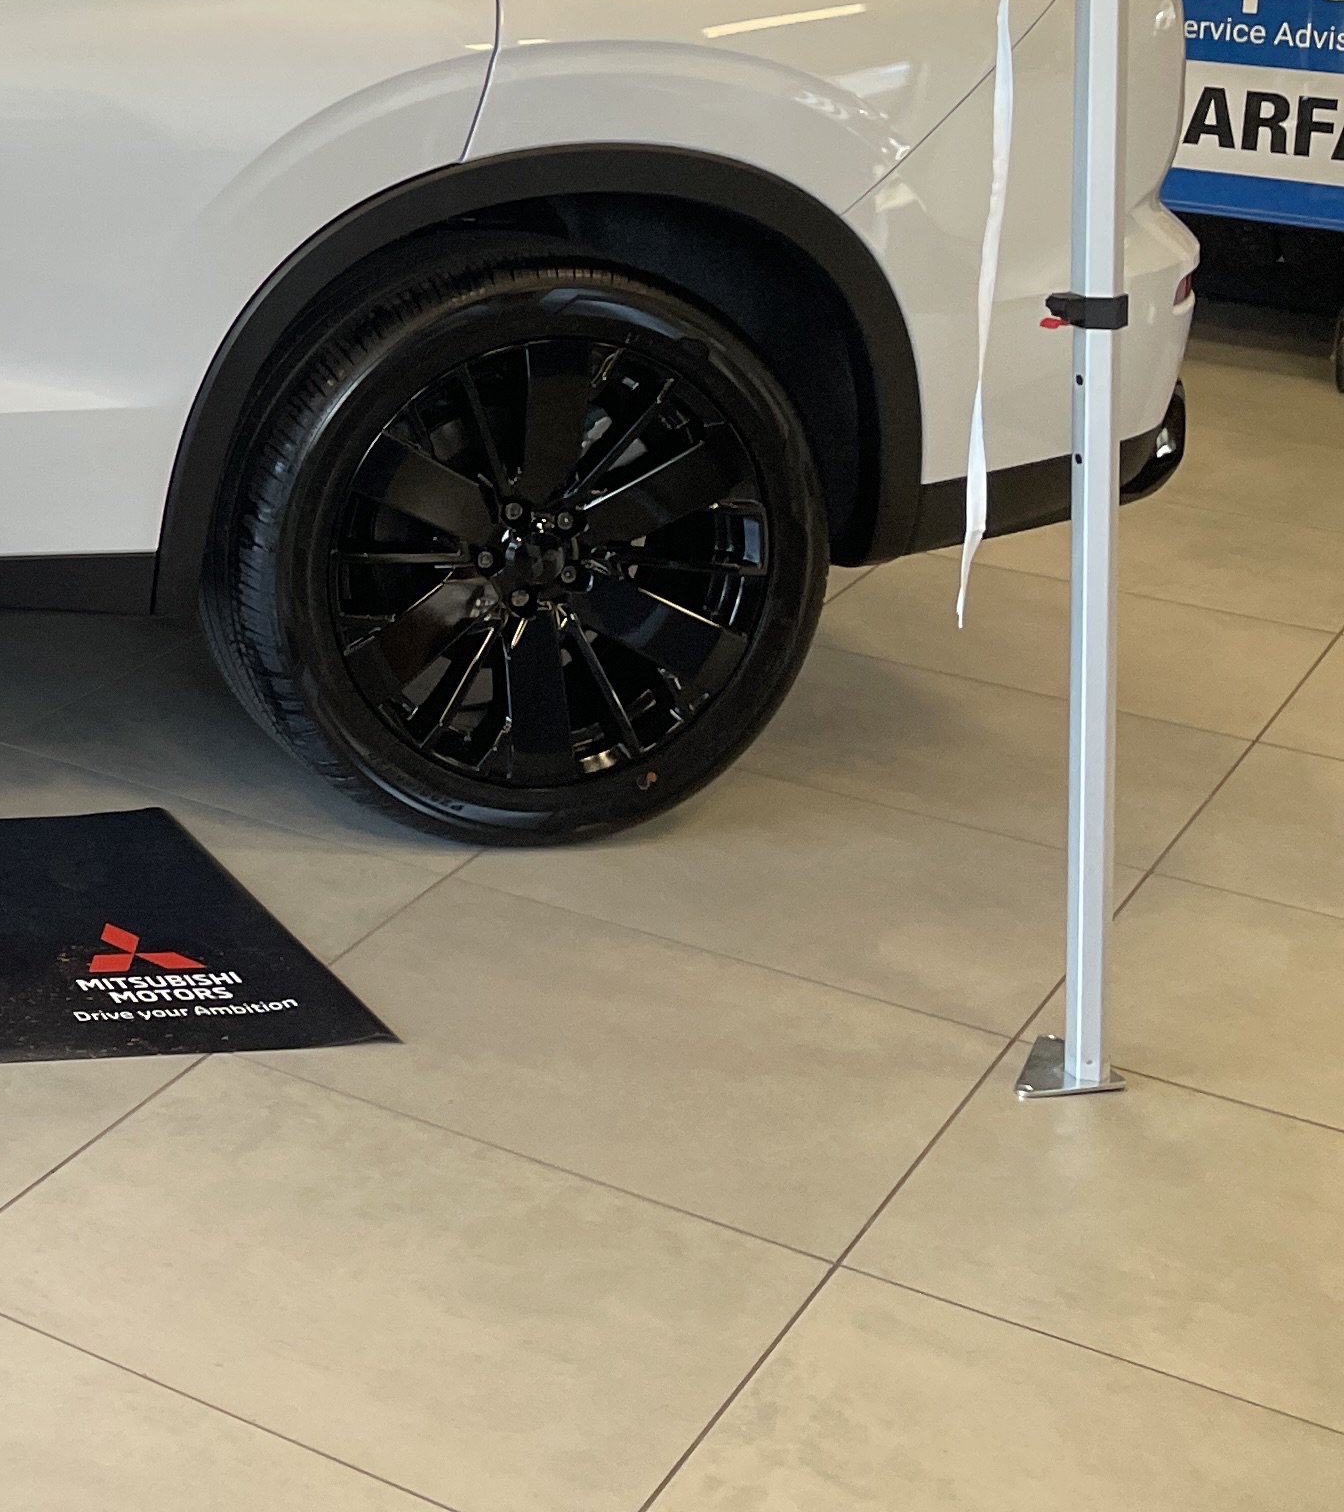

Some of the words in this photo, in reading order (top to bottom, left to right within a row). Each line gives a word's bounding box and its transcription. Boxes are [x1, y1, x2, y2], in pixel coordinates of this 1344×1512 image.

[76, 971, 243, 992] MITSUBISHI
[108, 986, 234, 1005] MOTORS
[73, 1009, 135, 1022] Drive
[136, 1006, 189, 1020] your
[193, 997, 299, 1017] Ambition
